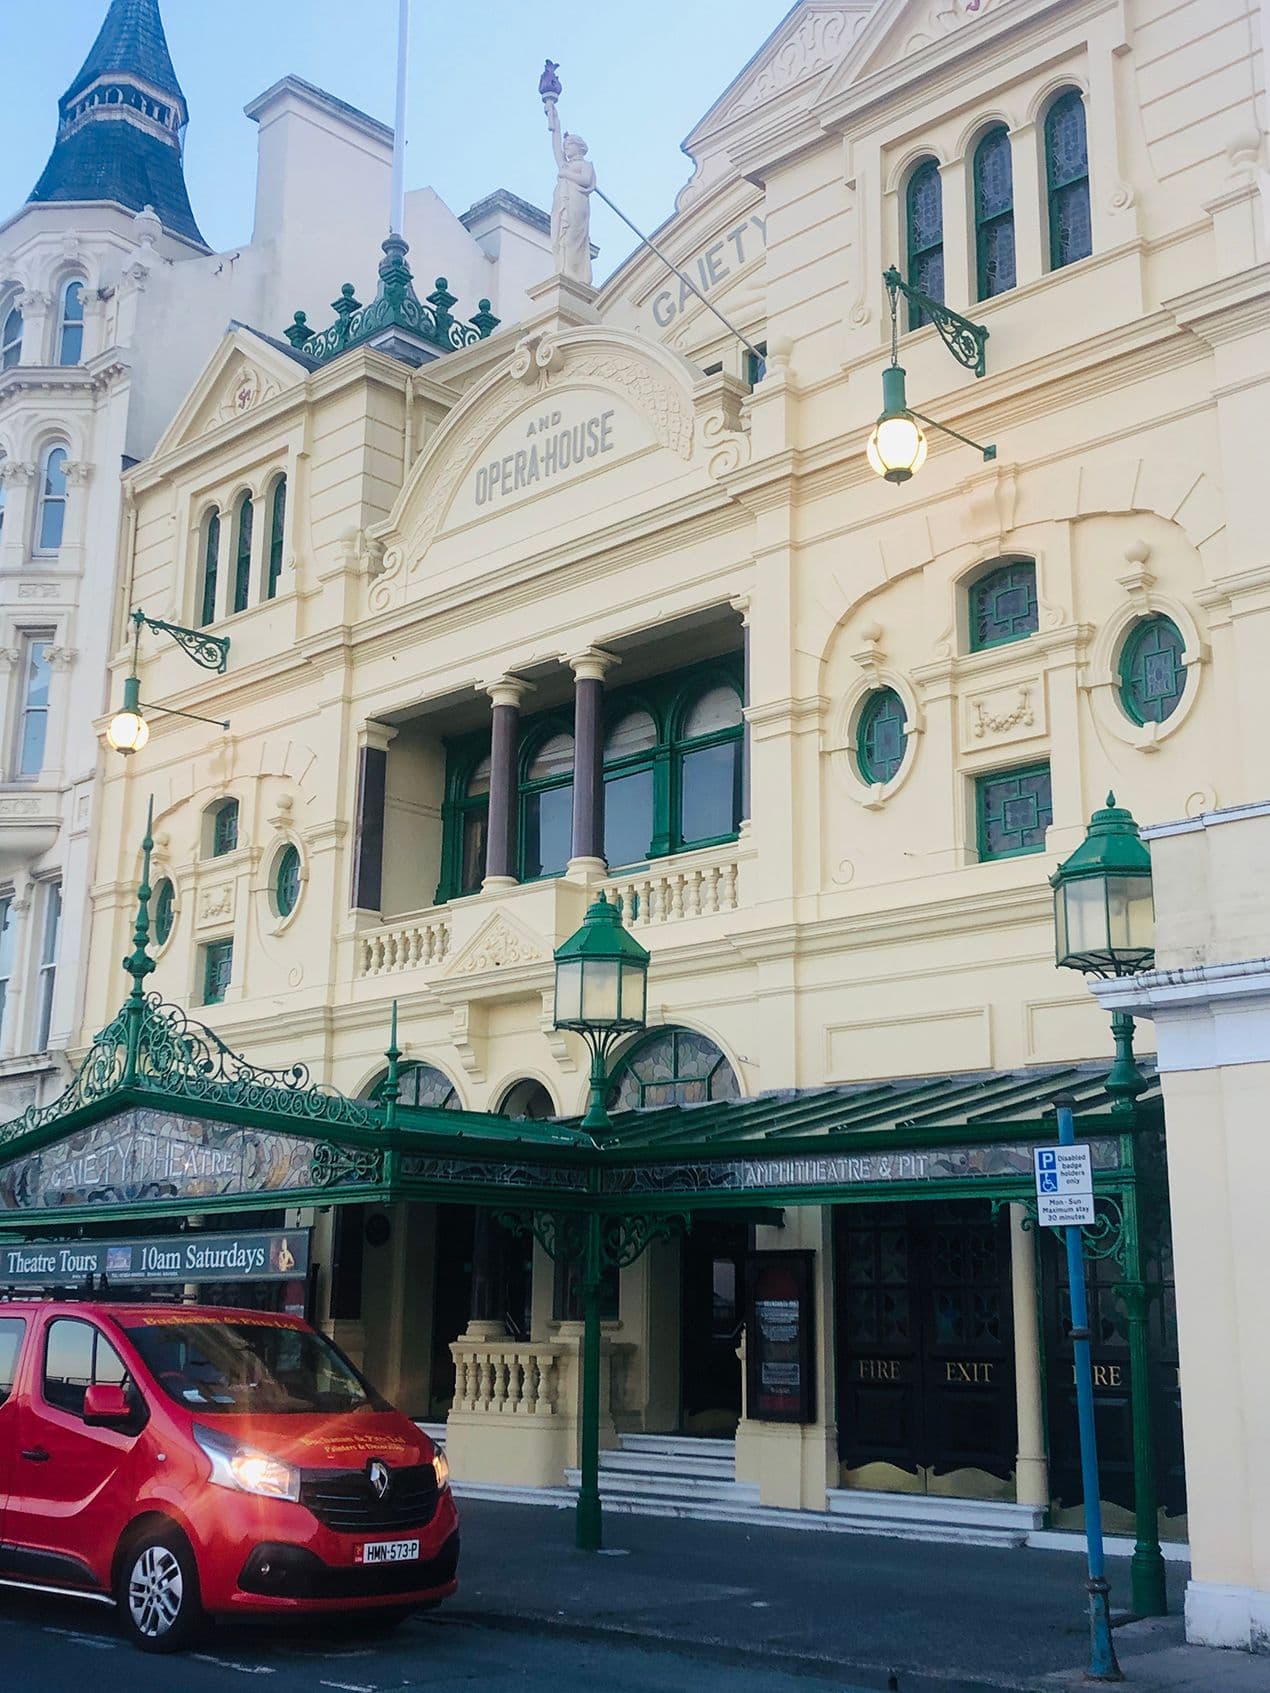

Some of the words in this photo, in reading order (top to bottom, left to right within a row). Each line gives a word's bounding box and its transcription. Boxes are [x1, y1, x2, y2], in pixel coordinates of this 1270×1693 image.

[653, 215, 767, 328] GAIETY
[526, 410, 562, 438] AND
[51, 1135, 134, 1187] GAIETY
[135, 1136, 233, 1182] THEATRE
[744, 1158, 871, 1185] AMPHITHEATRE
[878, 1156, 892, 1177] &
[898, 1155, 929, 1177] PIT
[1042, 1153, 1053, 1168] P
[1057, 1154, 1087, 1162] Disabled
[1062, 1162, 1082, 1170] badge
[7, 1251, 56, 1273] Theatre
[59, 1250, 98, 1271] Tours
[140, 1247, 181, 1271] 10am
[185, 1242, 265, 1273] Saturdays
[858, 1359, 902, 1381] FIRE
[945, 1362, 994, 1383] EXIT
[367, 1543, 418, 1560] HMN-573-P
